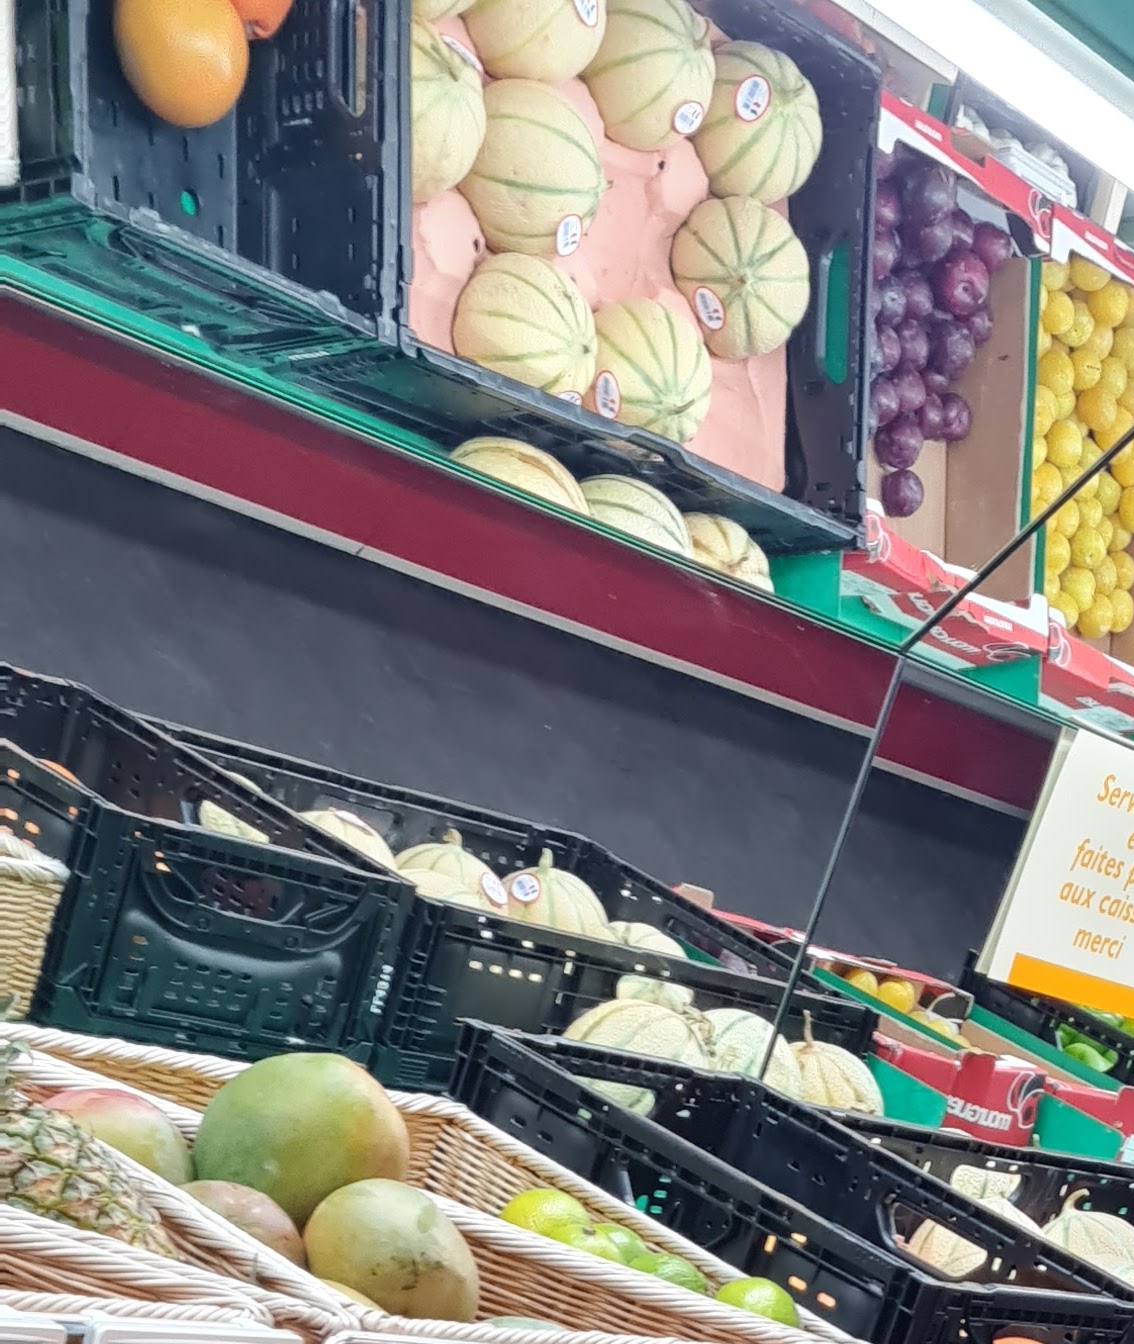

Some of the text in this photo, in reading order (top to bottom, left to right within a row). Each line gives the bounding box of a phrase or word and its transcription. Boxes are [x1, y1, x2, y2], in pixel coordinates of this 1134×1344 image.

[1070, 838, 1125, 880] faites
[1059, 881, 1093, 910] aux
[1073, 925, 1127, 960] merci
